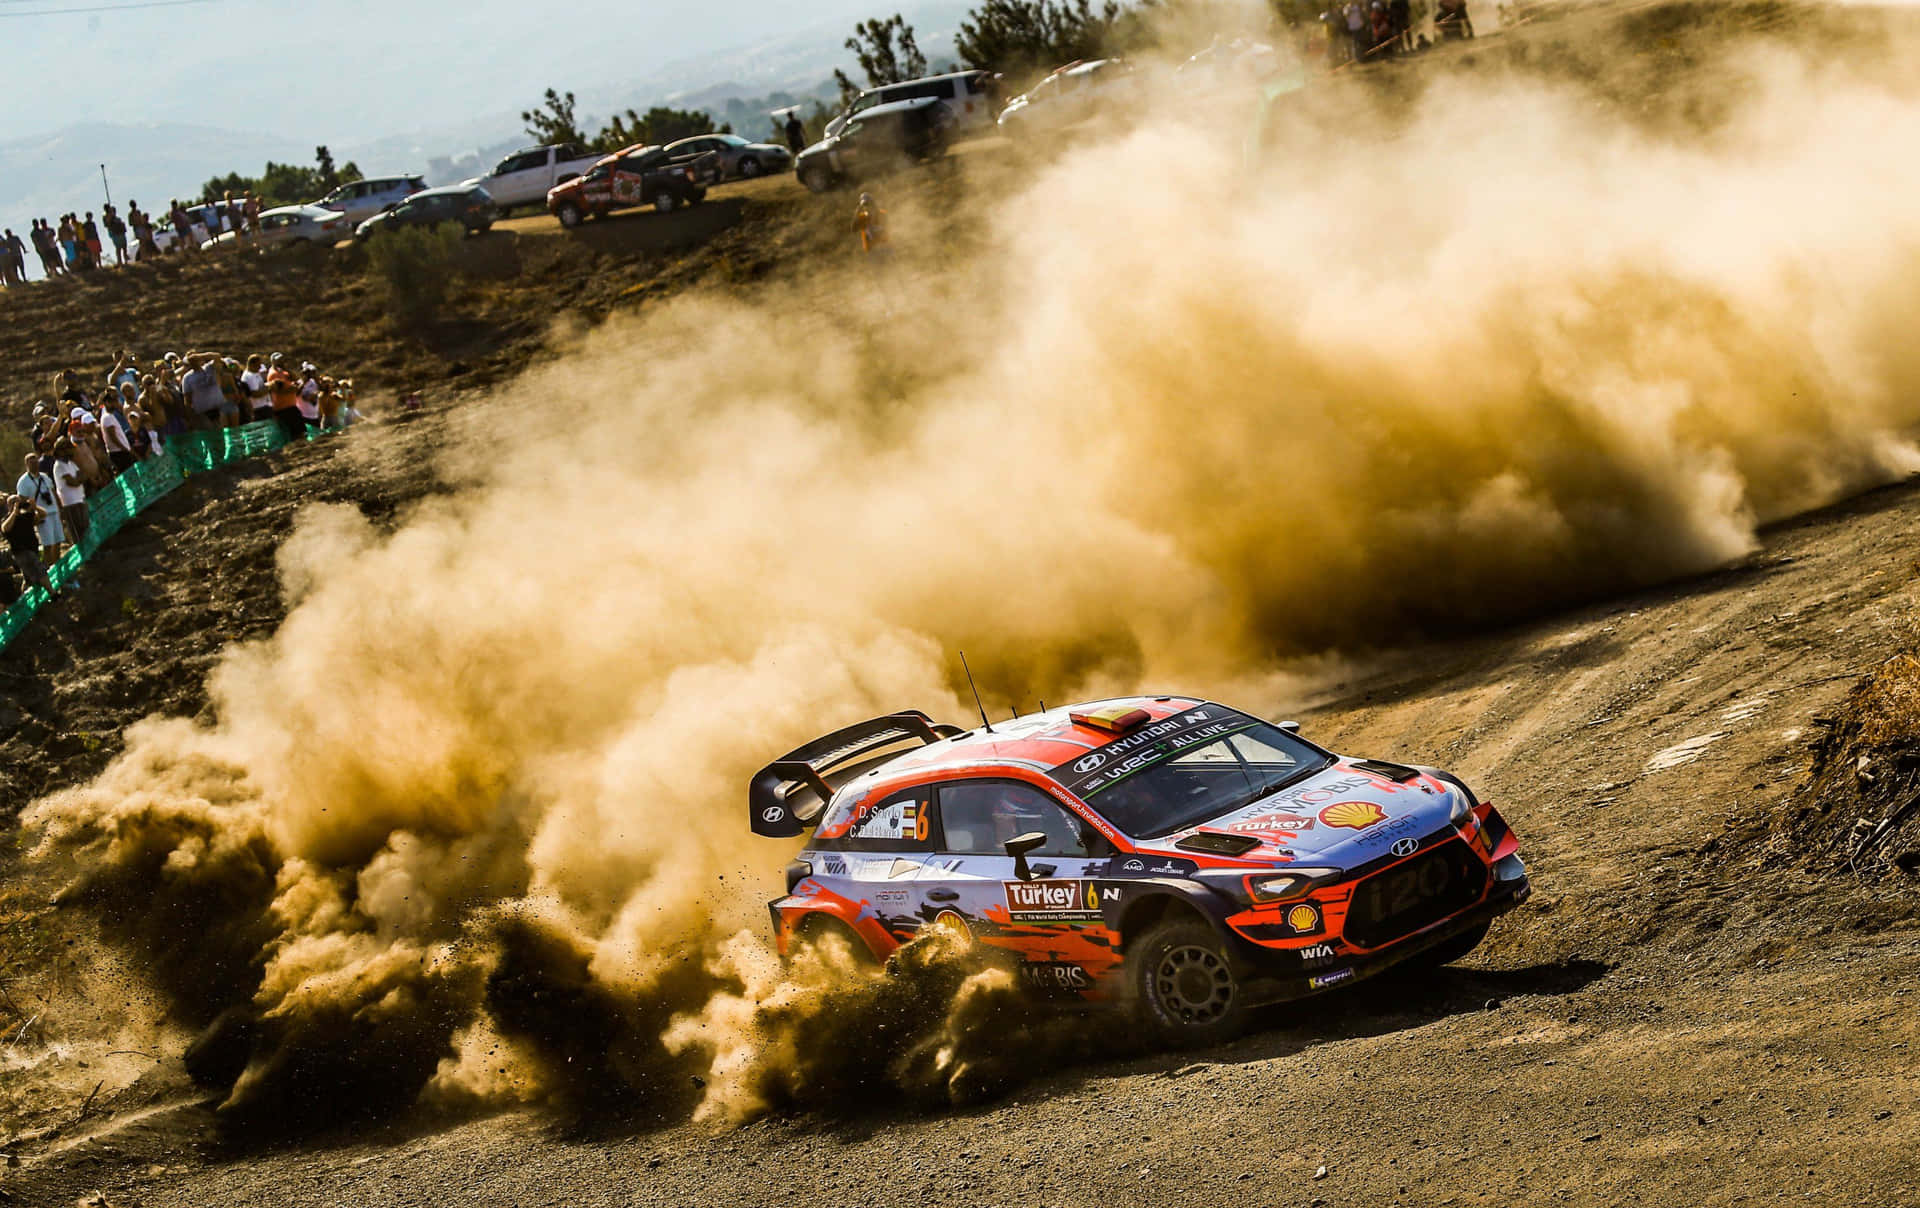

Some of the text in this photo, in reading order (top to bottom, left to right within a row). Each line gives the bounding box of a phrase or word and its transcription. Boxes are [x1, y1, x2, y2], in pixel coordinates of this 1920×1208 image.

[1106, 721, 1182, 755] HYUNDAI
[1171, 734, 1201, 748] ALL
[1195, 723, 1229, 738] LIVE
[1241, 787, 1311, 820] HYUNDAI
[1275, 776, 1373, 814] MOBIS
[916, 800, 929, 842] 6
[1050, 786, 1116, 839] motorsport.hyundai.com
[1233, 817, 1311, 832] Turkey
[1009, 883, 1076, 908] Turkey
[1087, 881, 1099, 910] 6
[1022, 966, 1088, 987] MBIS
